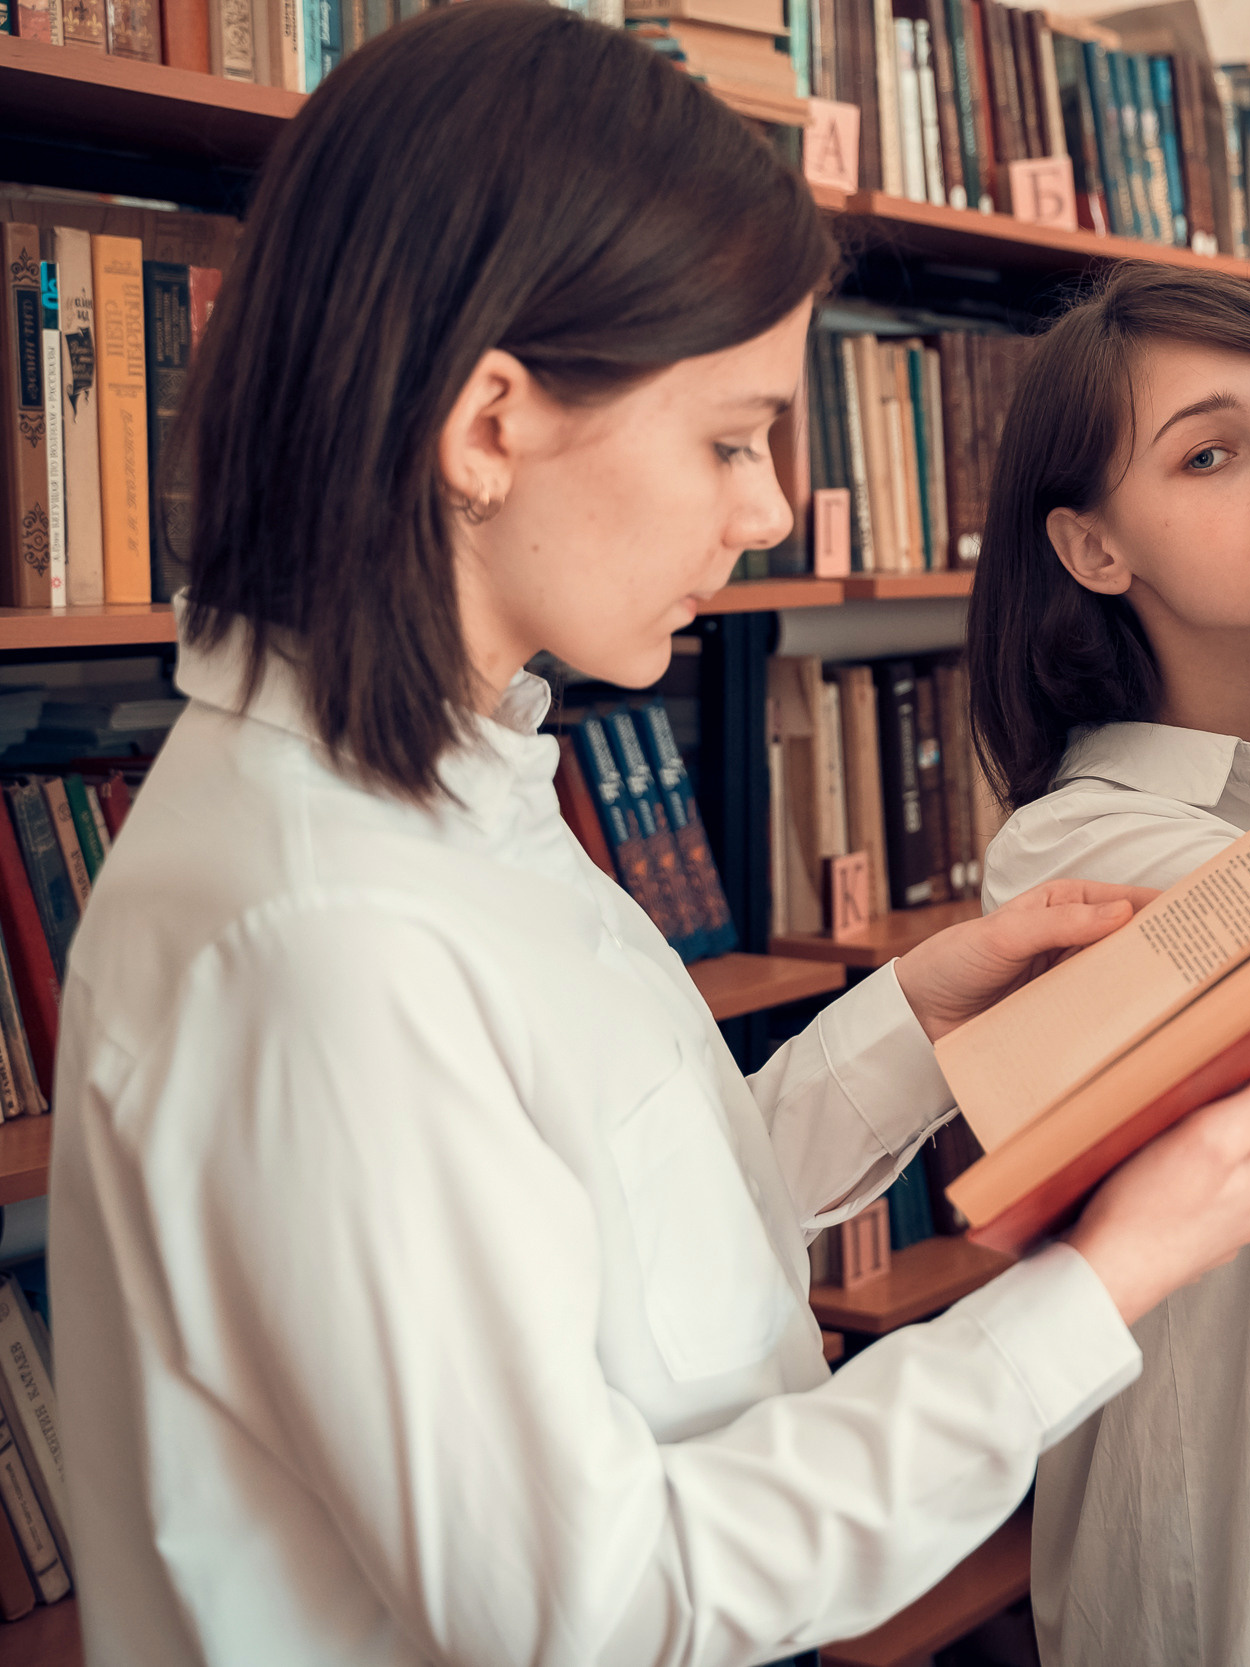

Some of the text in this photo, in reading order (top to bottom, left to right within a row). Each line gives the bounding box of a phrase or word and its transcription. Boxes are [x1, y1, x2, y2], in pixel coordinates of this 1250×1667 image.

[815, 118, 846, 175] А
[1029, 166, 1065, 220] Б
[104, 299, 125, 358] ПЕТР
[122, 283, 144, 377] ПЕРВЫЙ
[839, 862, 863, 928] К
[9, 1341, 66, 1485] ЛЕНТИН КАТАЕВ
